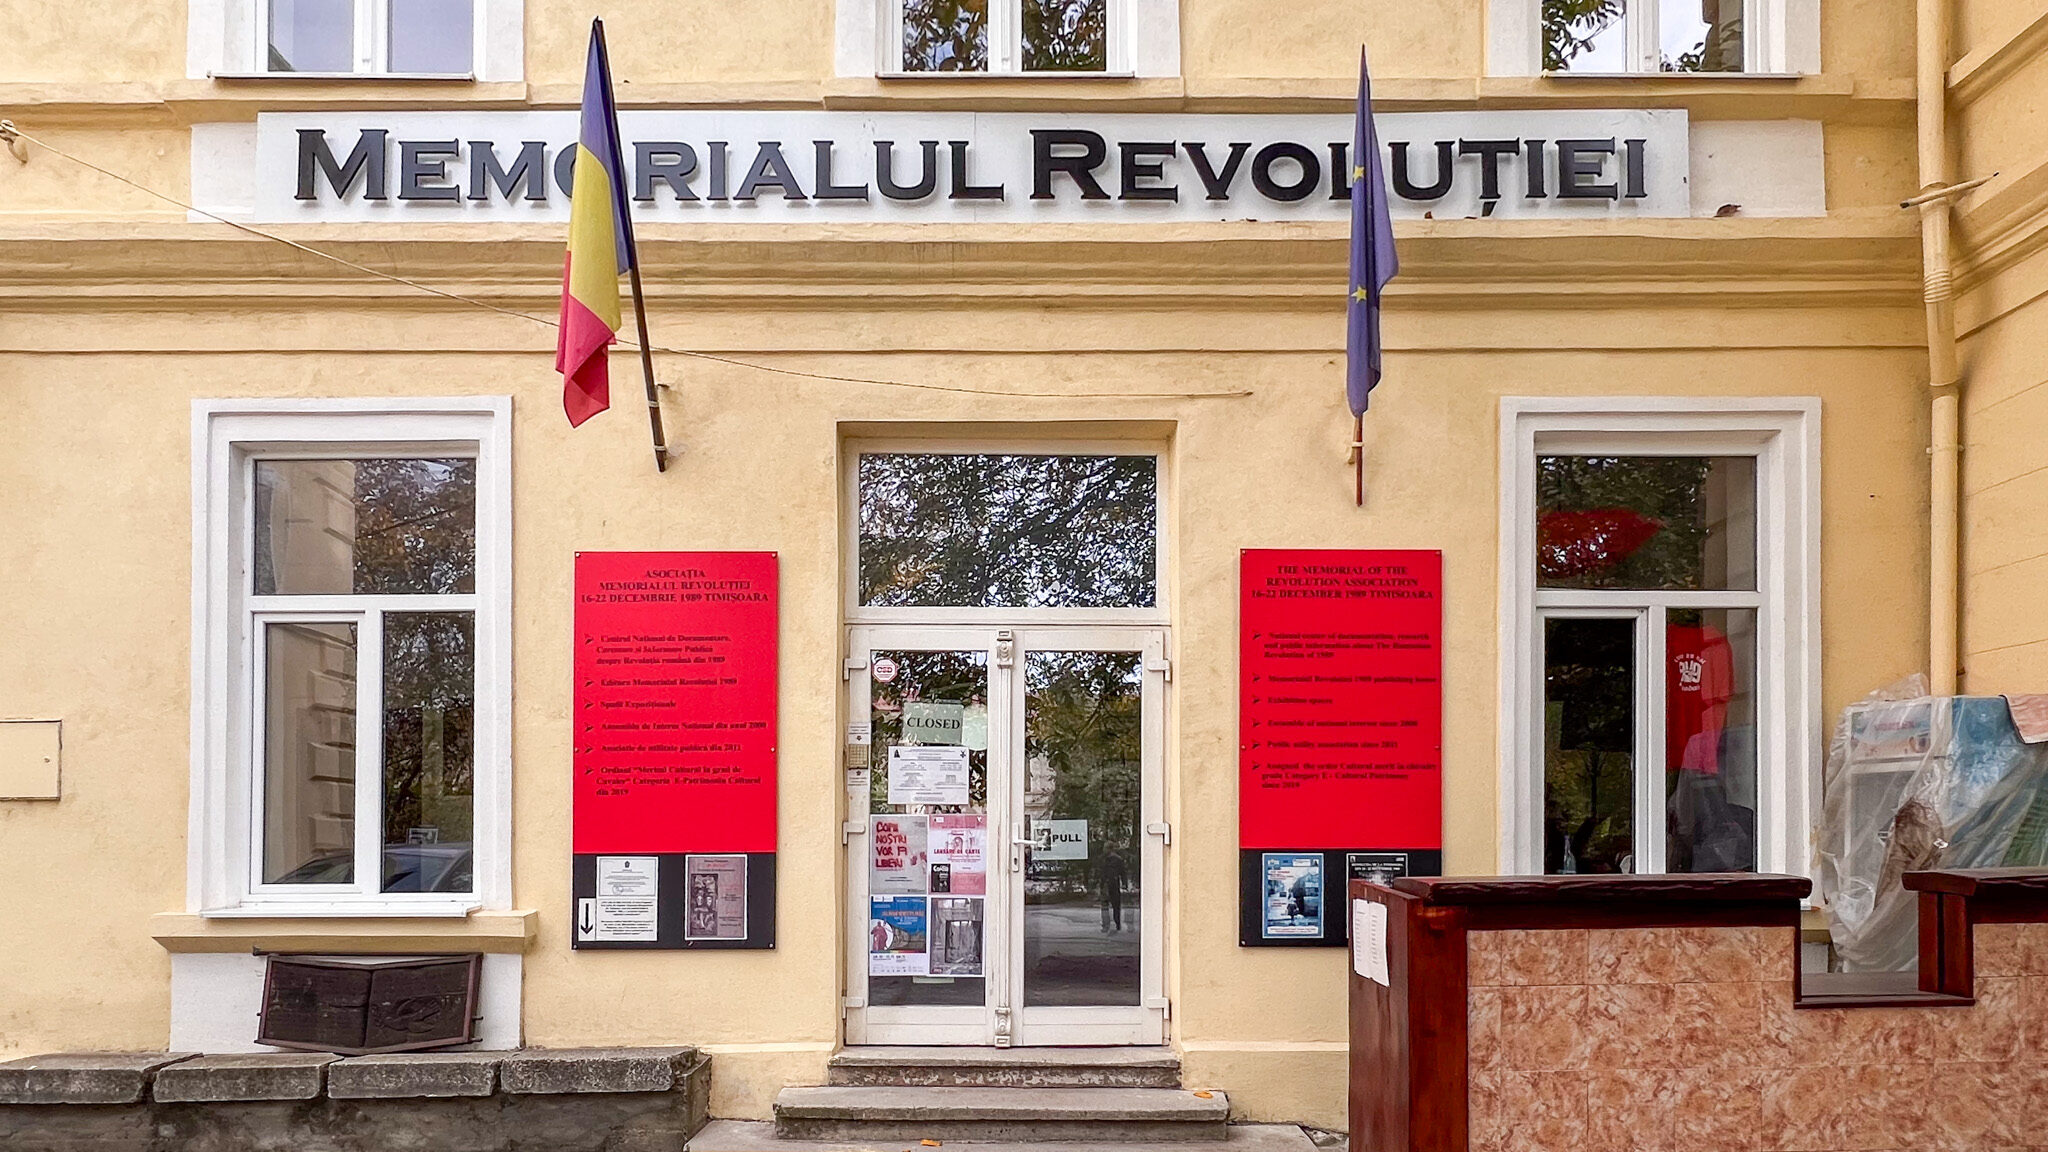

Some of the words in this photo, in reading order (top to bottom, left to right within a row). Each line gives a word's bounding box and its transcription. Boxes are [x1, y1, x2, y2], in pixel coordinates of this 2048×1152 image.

[646, 568, 706, 580] ASOCIAȚIA
[1278, 566, 1298, 576] THE
[1303, 566, 1365, 576] MEMORIAL
[1368, 566, 1382, 576] OF
[1385, 566, 1408, 576] THE
[599, 581, 678, 591] MEMORIALUL
[681, 581, 751, 593] REVOLUȚIEI
[1266, 577, 1341, 588] REVOLUTION
[1345, 577, 1418, 588] ASSOCIATION
[582, 593, 607, 603] 16-22
[610, 593, 677, 603] DECEMBRIE
[681, 593, 702, 603] 1989
[704, 593, 769, 604] TIMIȘOARA
[1252, 589, 1276, 599] 16-22
[1279, 589, 1342, 599] DECEMBER
[1346, 589, 1368, 599] 1989
[667, 635, 676, 643] de
[906, 716, 961, 730] CLOSED
[1052, 834, 1082, 843] PULL
[876, 846, 894, 857] VOR
